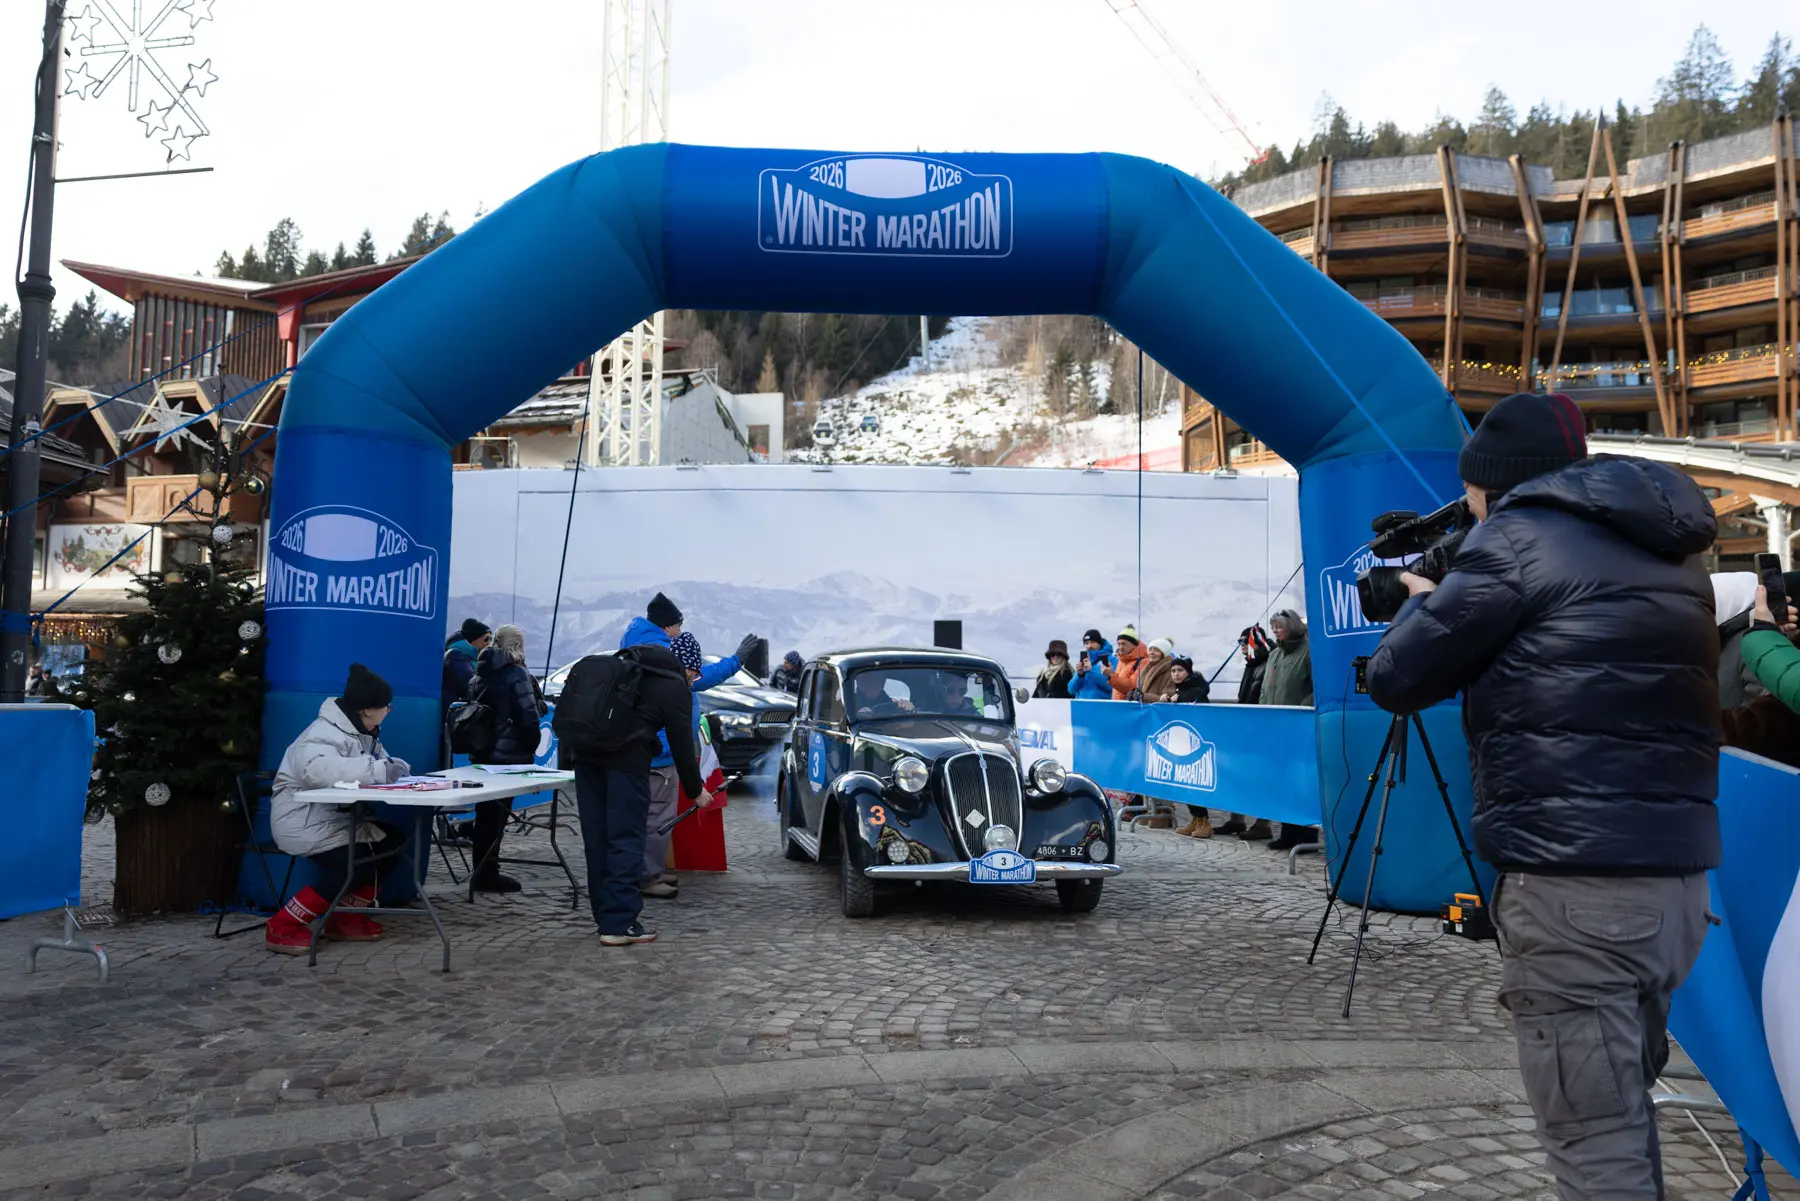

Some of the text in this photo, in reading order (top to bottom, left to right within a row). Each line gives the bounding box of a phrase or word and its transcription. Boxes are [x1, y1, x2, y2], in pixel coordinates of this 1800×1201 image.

[809, 161, 962, 193] 2026 2026
[771, 174, 1001, 250] WINTER MARATHON
[281, 520, 408, 558] 2026 2026
[266, 546, 433, 613] WINTER MARATHON
[812, 751, 820, 778] 3
[1174, 747, 1213, 787] MARATHON
[868, 805, 886, 825] 3
[1001, 857, 1007, 866] 3
[1037, 846, 1083, 856] 4806 BZ
[975, 861, 1032, 880] WINTER MARATHON
